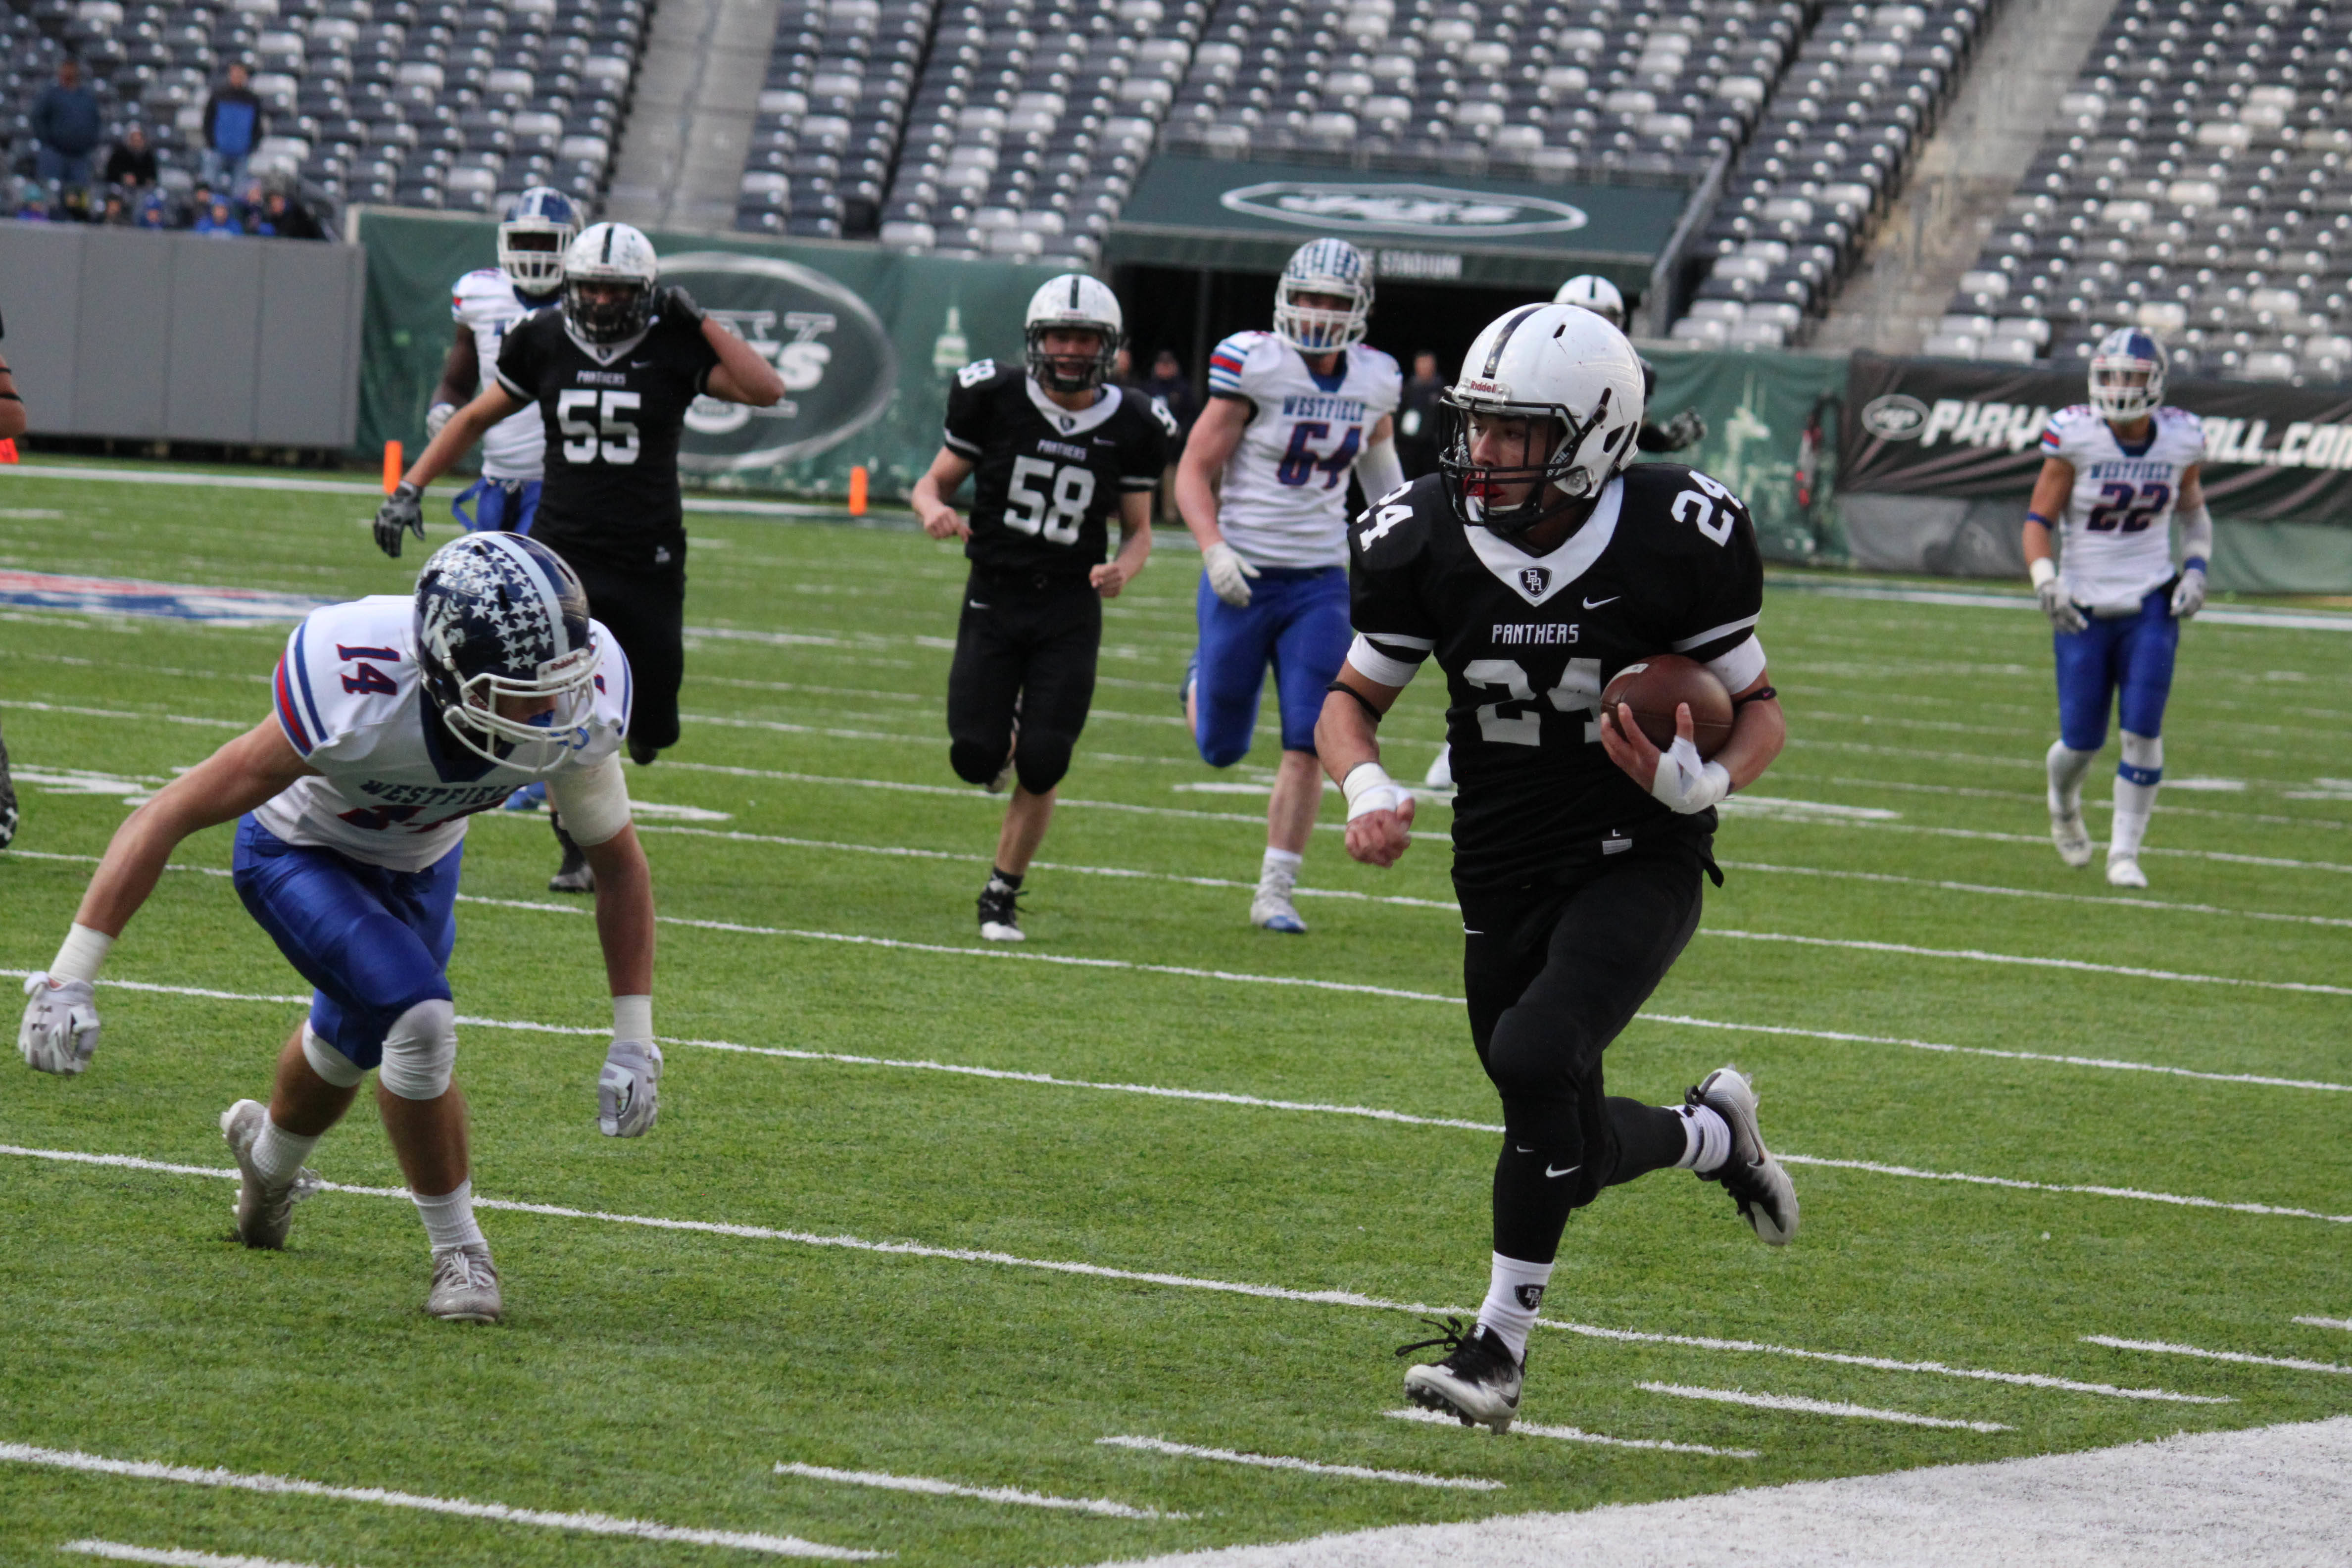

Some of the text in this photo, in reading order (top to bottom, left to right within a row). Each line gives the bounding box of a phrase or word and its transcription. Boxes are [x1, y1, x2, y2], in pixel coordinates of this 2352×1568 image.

[1379, 249, 1463, 280] STADIUM
[557, 389, 641, 465] 55
[1277, 421, 1363, 490] 64
[1003, 454, 1096, 545] 58
[1670, 470, 1743, 547] 24
[2086, 481, 2170, 533] 22
[1491, 624, 1580, 644] PANTHERS
[336, 643, 400, 696] 14
[1463, 657, 1602, 746] 24
[1612, 829, 1621, 837] L
